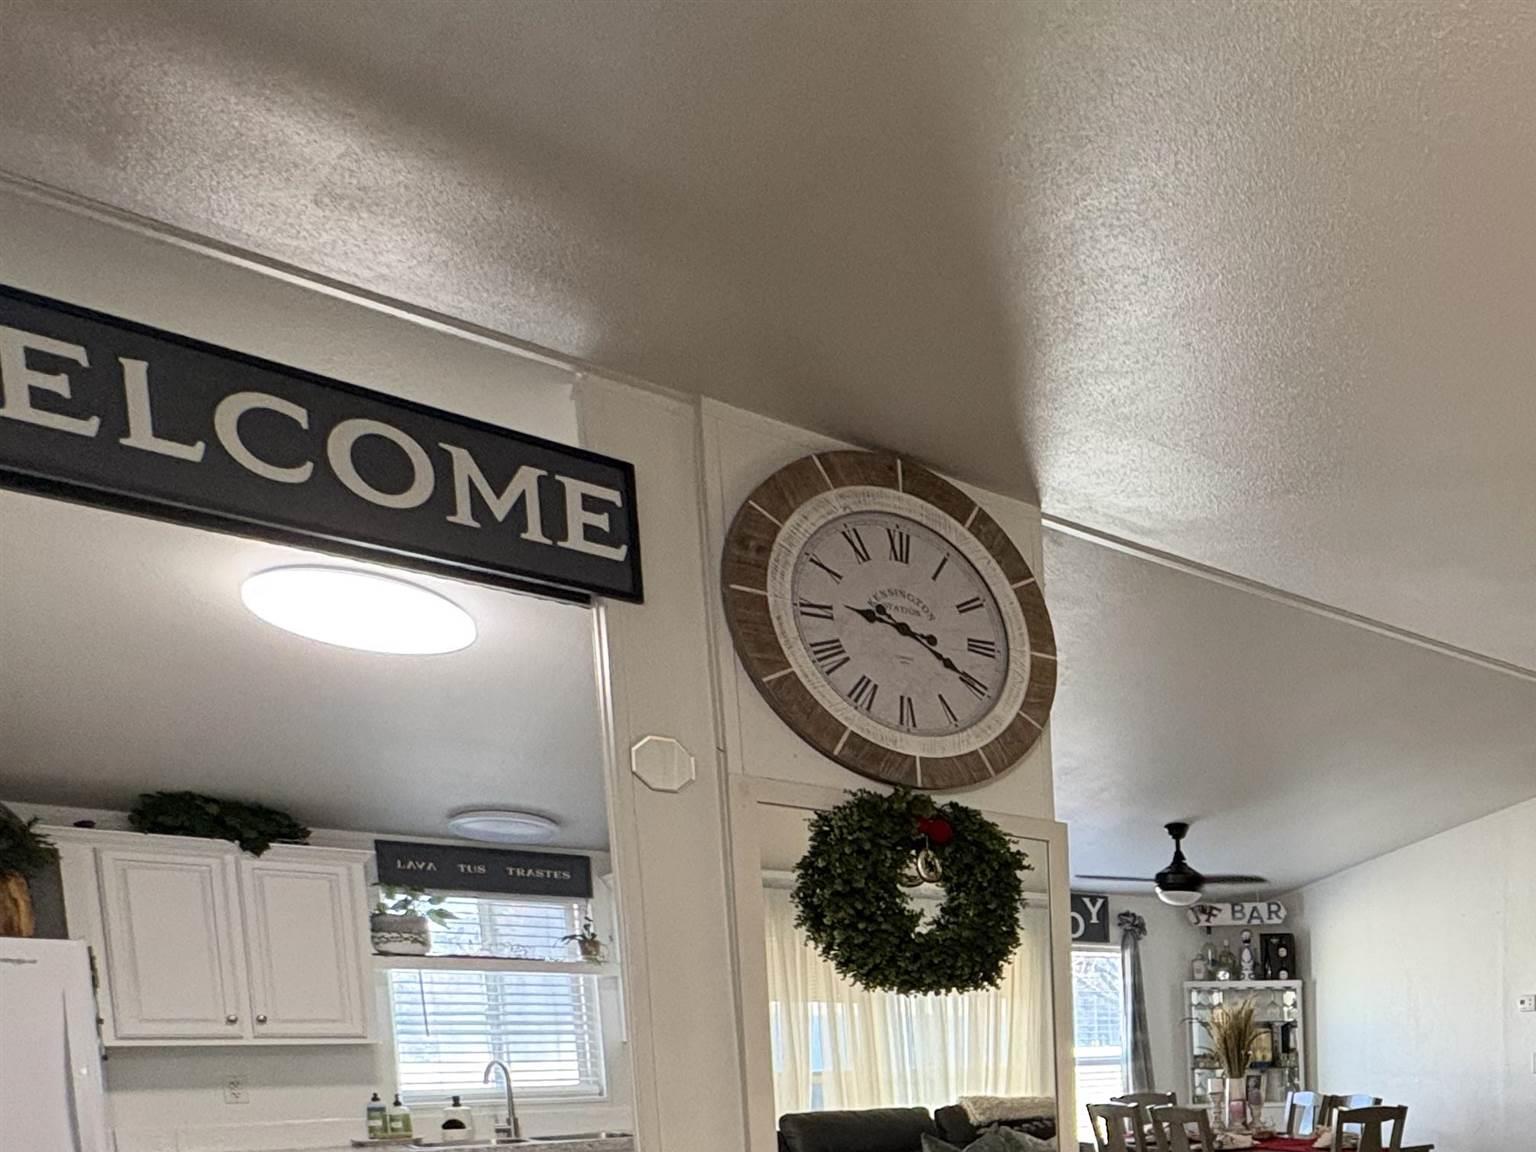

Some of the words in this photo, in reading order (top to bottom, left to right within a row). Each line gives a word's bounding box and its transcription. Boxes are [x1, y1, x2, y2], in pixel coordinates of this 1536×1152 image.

[0, 325, 627, 561] ELCOME
[842, 527, 871, 565] XI
[887, 528, 910, 564] XII
[809, 553, 843, 585] X
[931, 557, 948, 581] I
[799, 597, 834, 620] IX
[956, 597, 984, 613] II
[809, 639, 851, 675] VIII
[967, 638, 996, 658] III
[847, 675, 878, 712] VII
[938, 694, 957, 724] V
[900, 695, 916, 728] VI
[397, 859, 438, 871] LAVA
[458, 863, 487, 875] TUS
[506, 866, 571, 879] TRASTES
[1231, 902, 1282, 924] BAR
